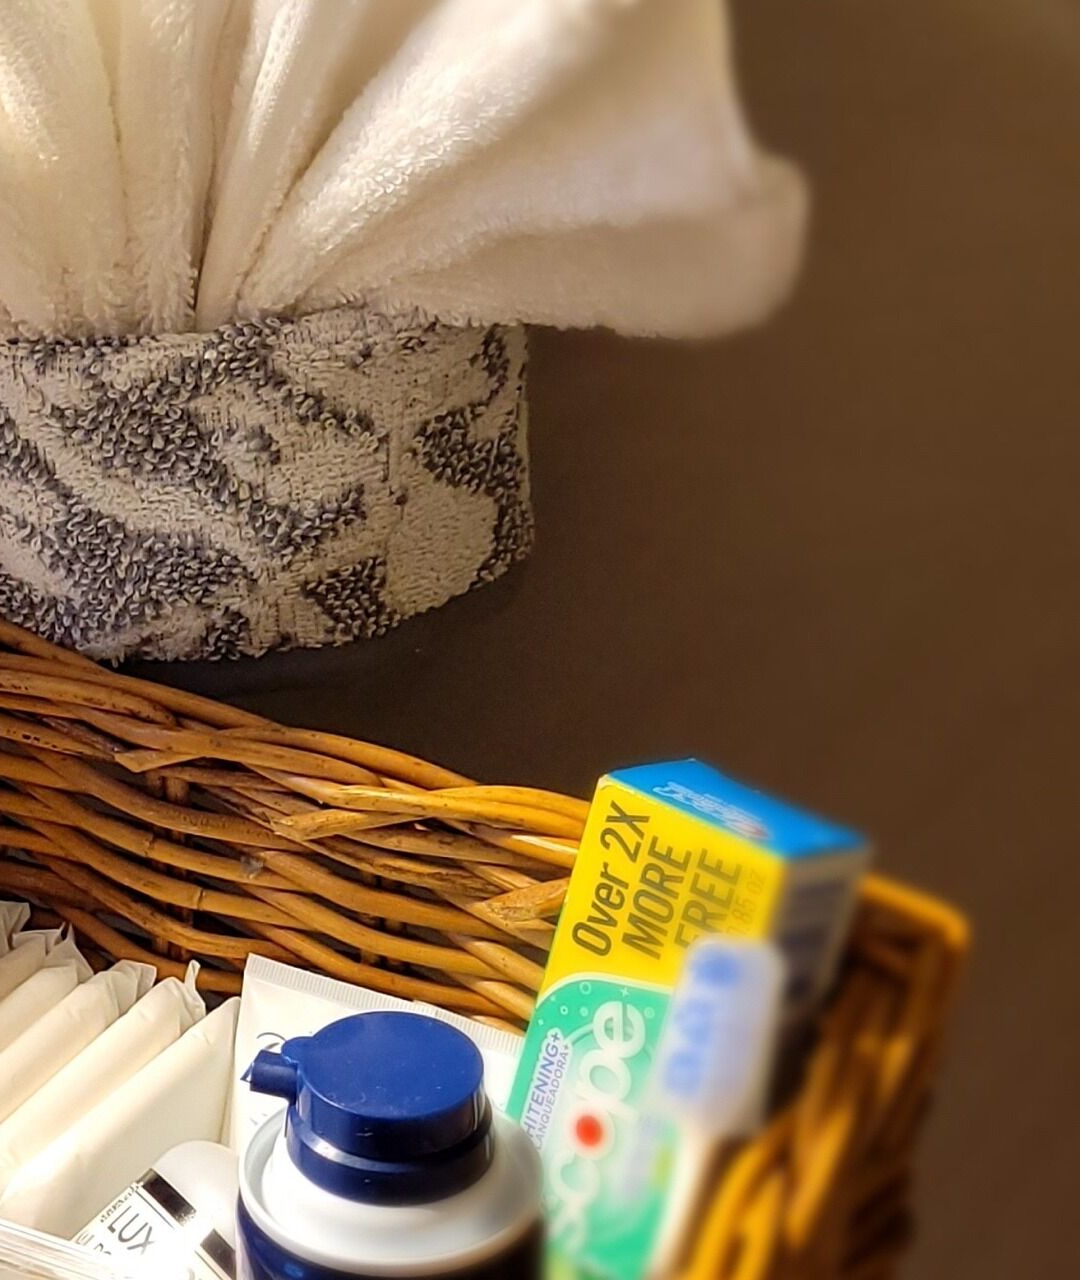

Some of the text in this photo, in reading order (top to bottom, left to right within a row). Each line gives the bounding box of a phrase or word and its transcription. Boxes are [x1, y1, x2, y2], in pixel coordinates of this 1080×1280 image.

[572, 800, 651, 956] Over 2X
[622, 835, 692, 960] MORE
[524, 1032, 560, 1138] HITENING+
[536, 1044, 569, 1151] LANQUEADORA+
